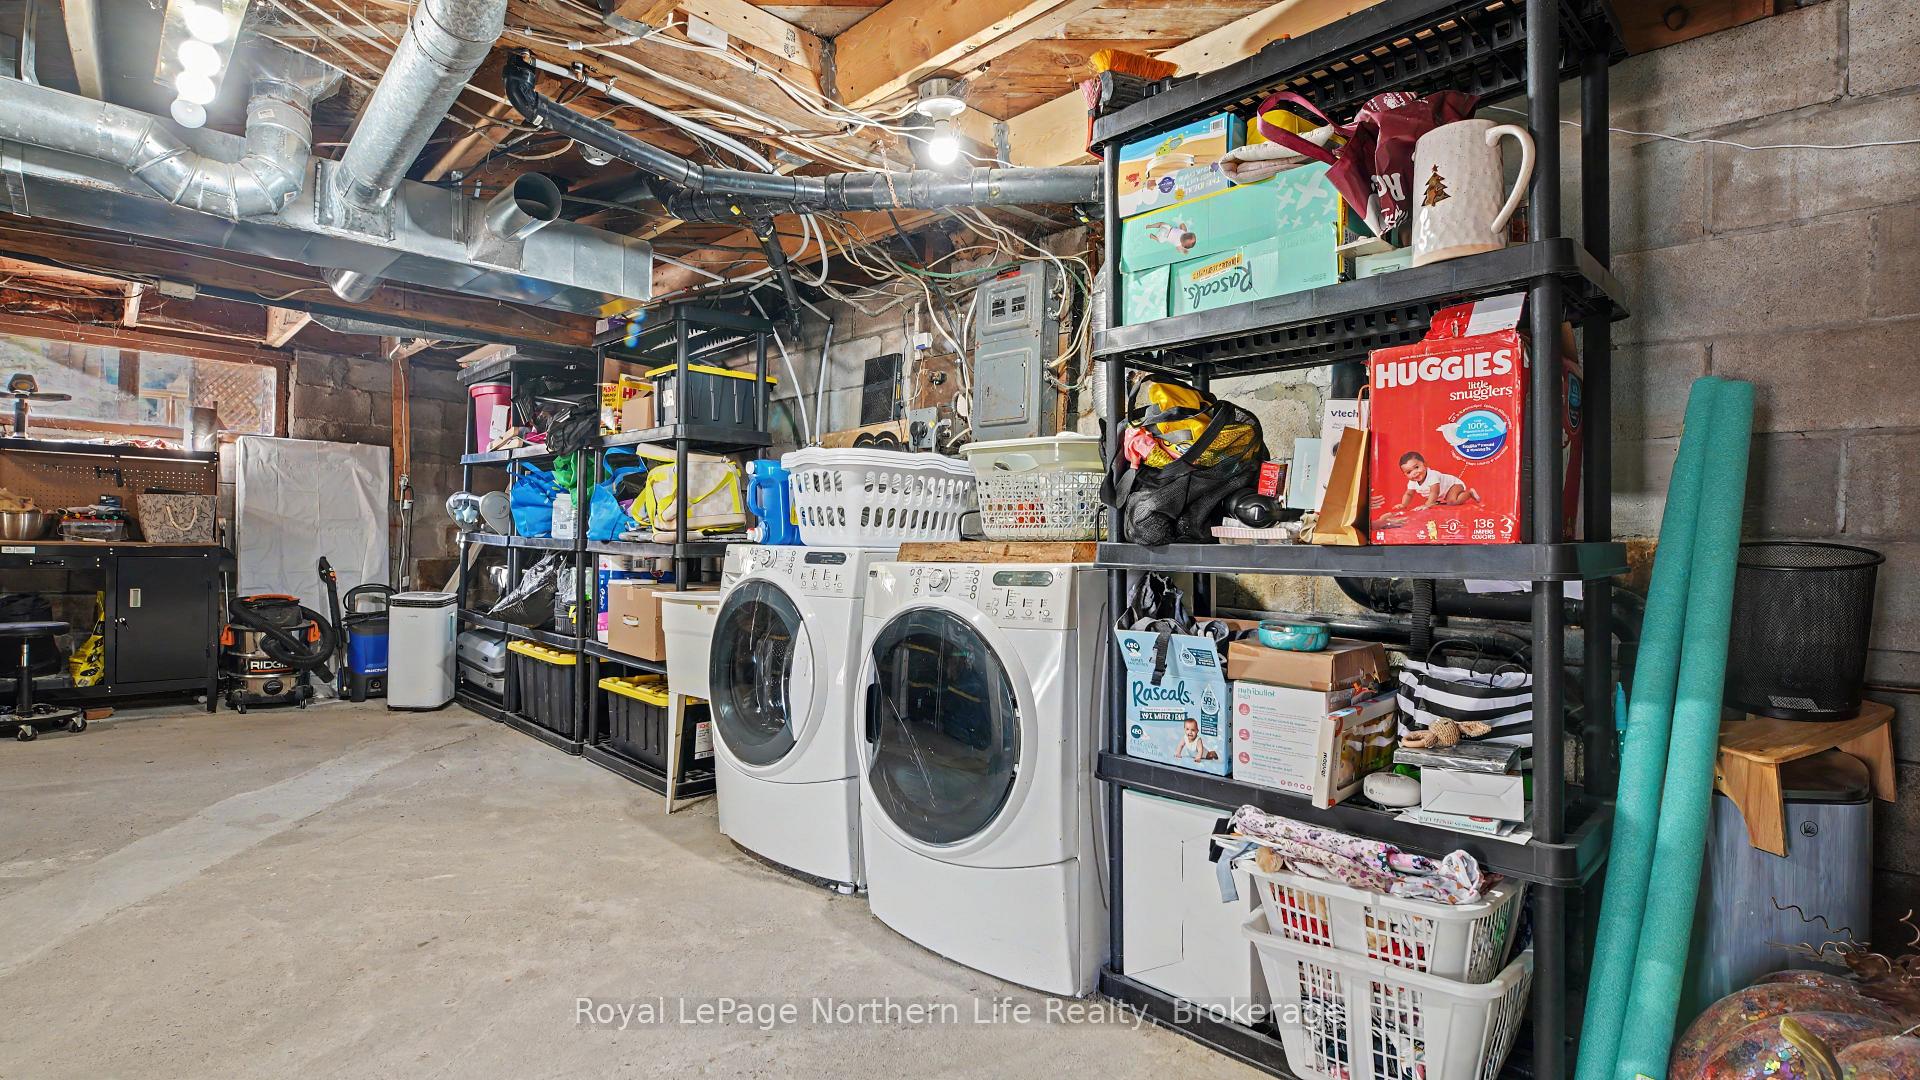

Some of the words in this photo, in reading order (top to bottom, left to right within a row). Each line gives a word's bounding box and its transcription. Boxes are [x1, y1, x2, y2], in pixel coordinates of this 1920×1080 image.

[1188, 260, 1253, 309] Rascals
[1375, 349, 1512, 389] HUGGIES
[1450, 385, 1513, 401] snugglers
[1468, 380, 1489, 390] little
[1331, 409, 1359, 418] vtech
[1473, 519, 1495, 529] 136
[1500, 518, 1513, 534] 3
[1133, 680, 1190, 707] Rascals
